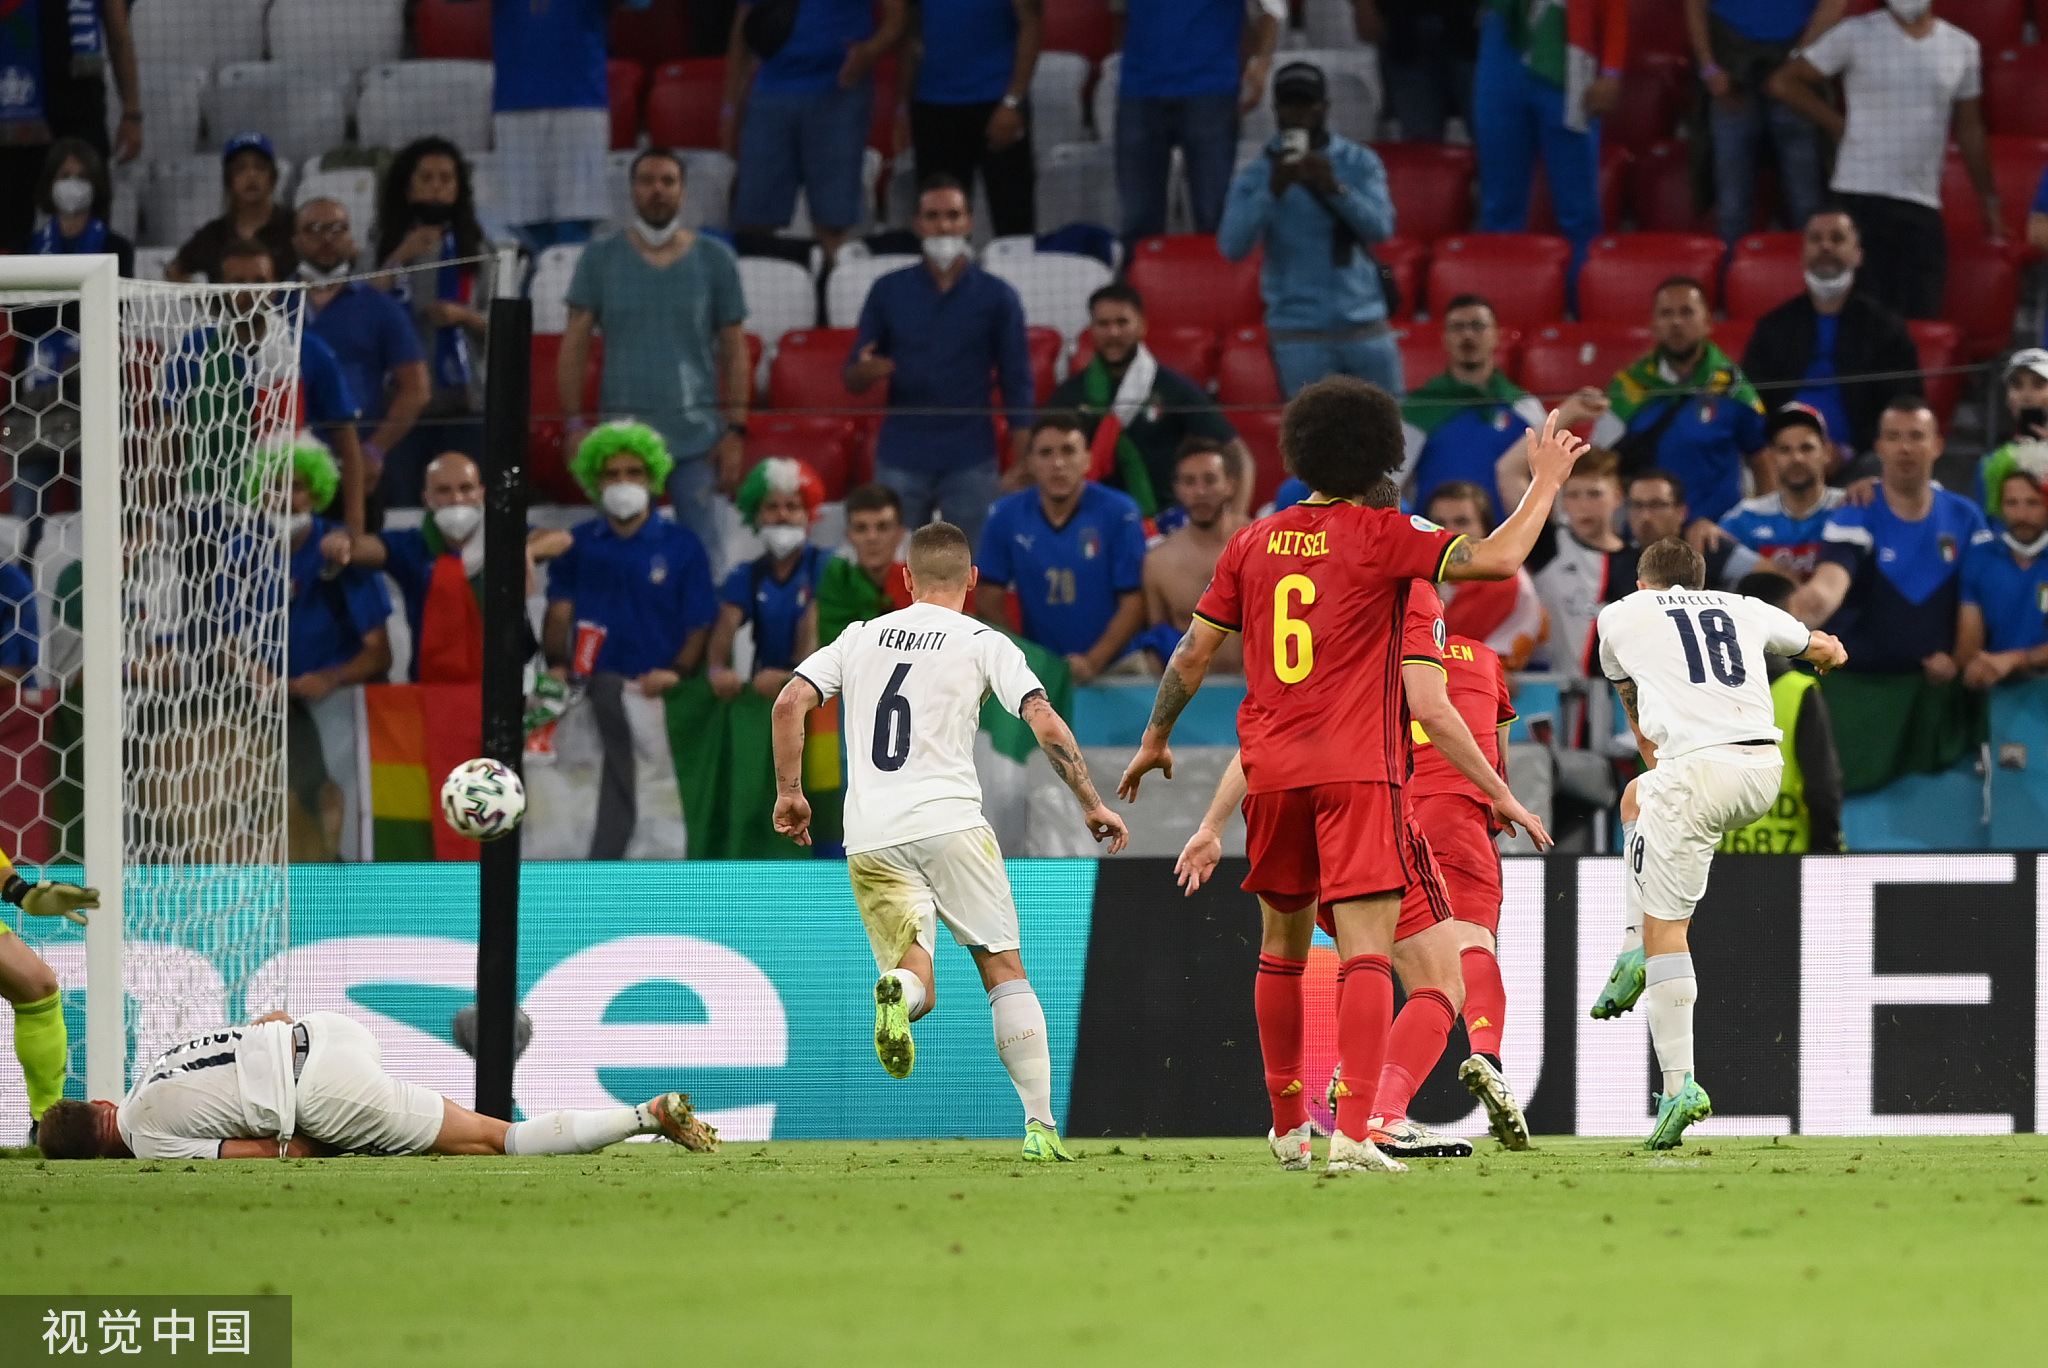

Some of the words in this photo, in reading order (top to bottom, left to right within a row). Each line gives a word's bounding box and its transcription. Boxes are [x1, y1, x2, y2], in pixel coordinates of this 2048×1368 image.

[1267, 531, 1330, 557] WITSEL
[878, 628, 947, 651] VERRATTI
[1274, 574, 1316, 684] 6
[1656, 595, 1728, 607] BARELLA
[1665, 608, 1746, 688] 18
[871, 663, 913, 772] 6
[1280, 854, 2048, 1138] ULE
